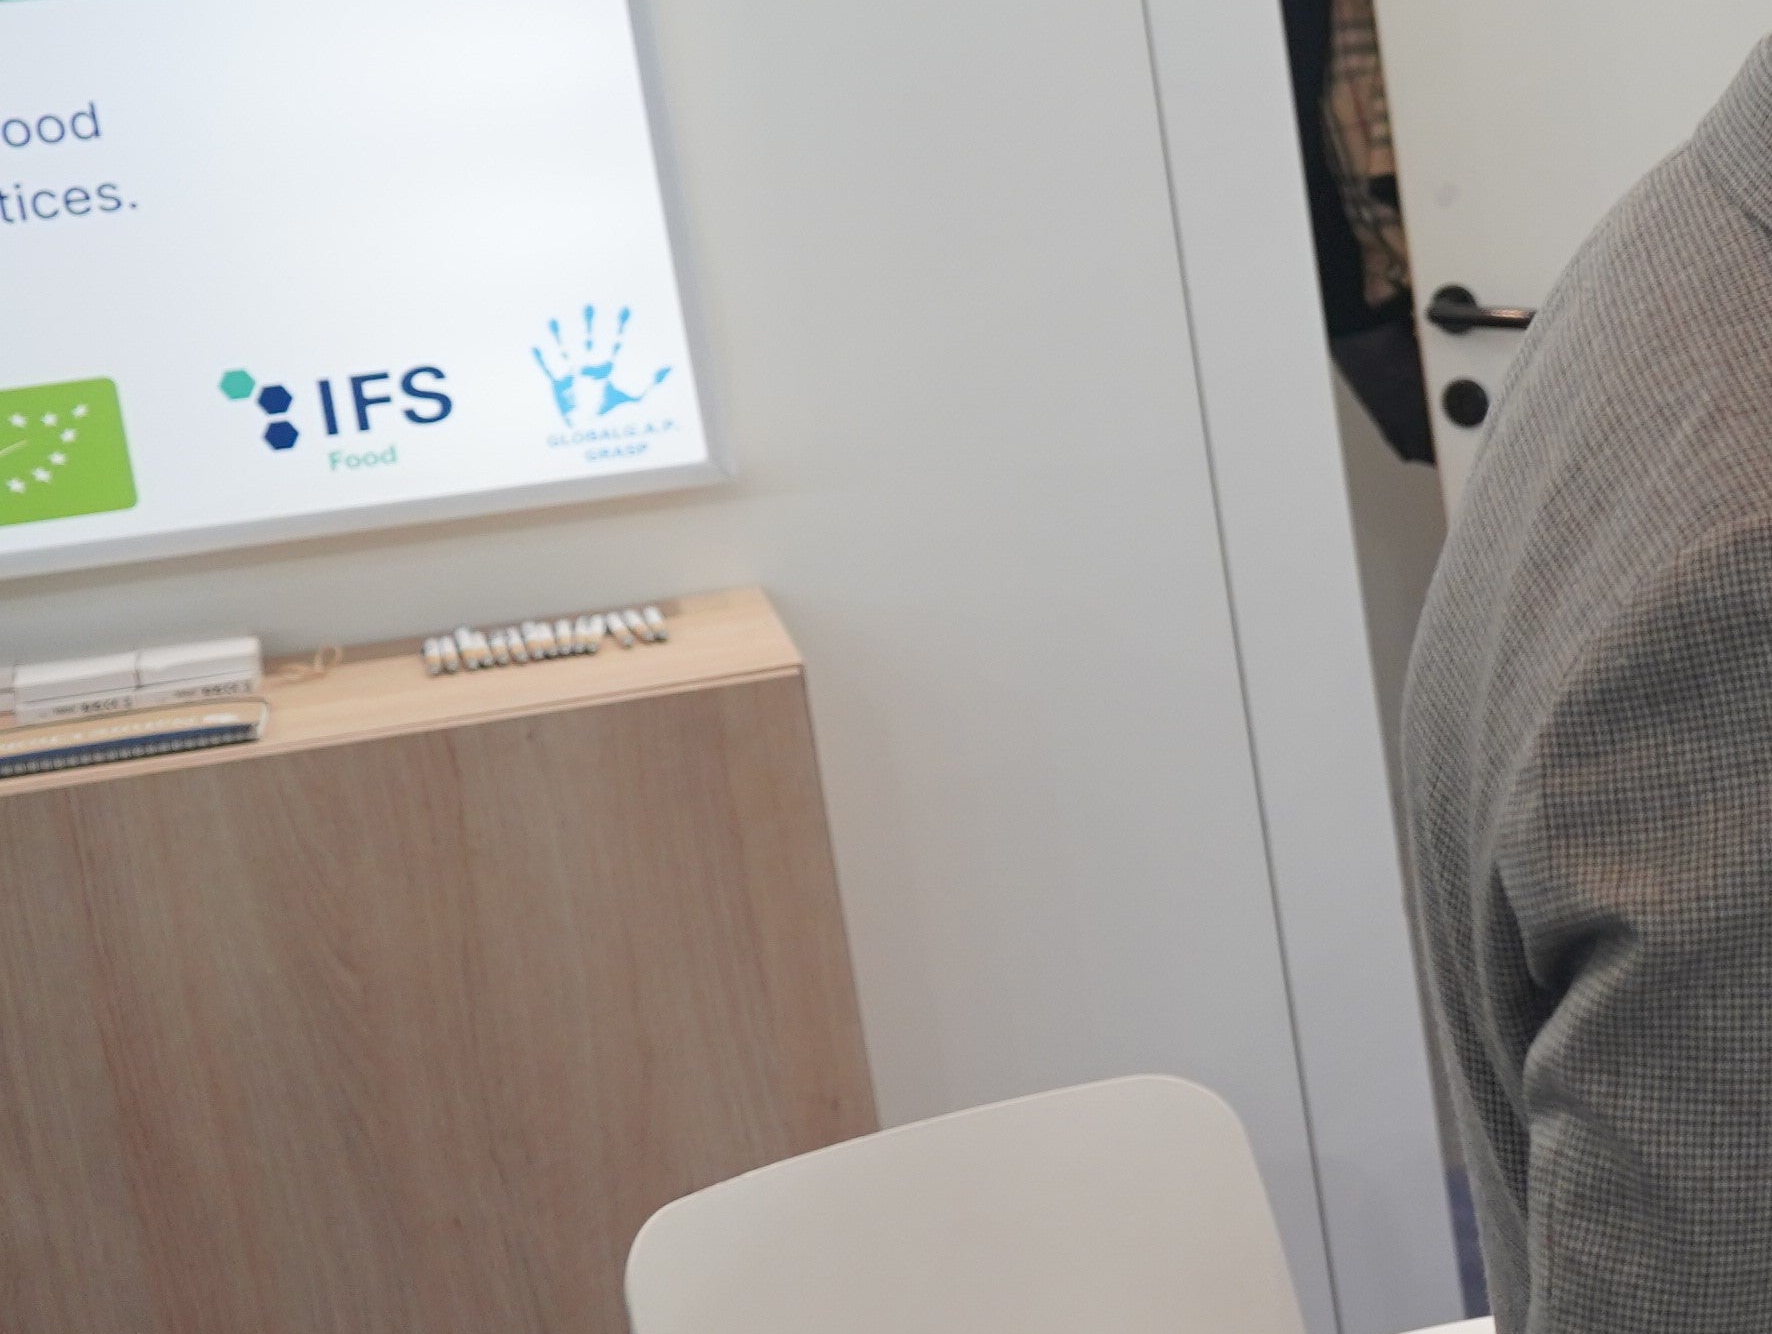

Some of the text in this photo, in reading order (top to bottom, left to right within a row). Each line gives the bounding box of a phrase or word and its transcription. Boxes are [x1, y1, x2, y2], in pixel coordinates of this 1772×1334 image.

[316, 365, 453, 436] IFS
[327, 443, 399, 472] Food
[585, 441, 649, 463] GRASP
